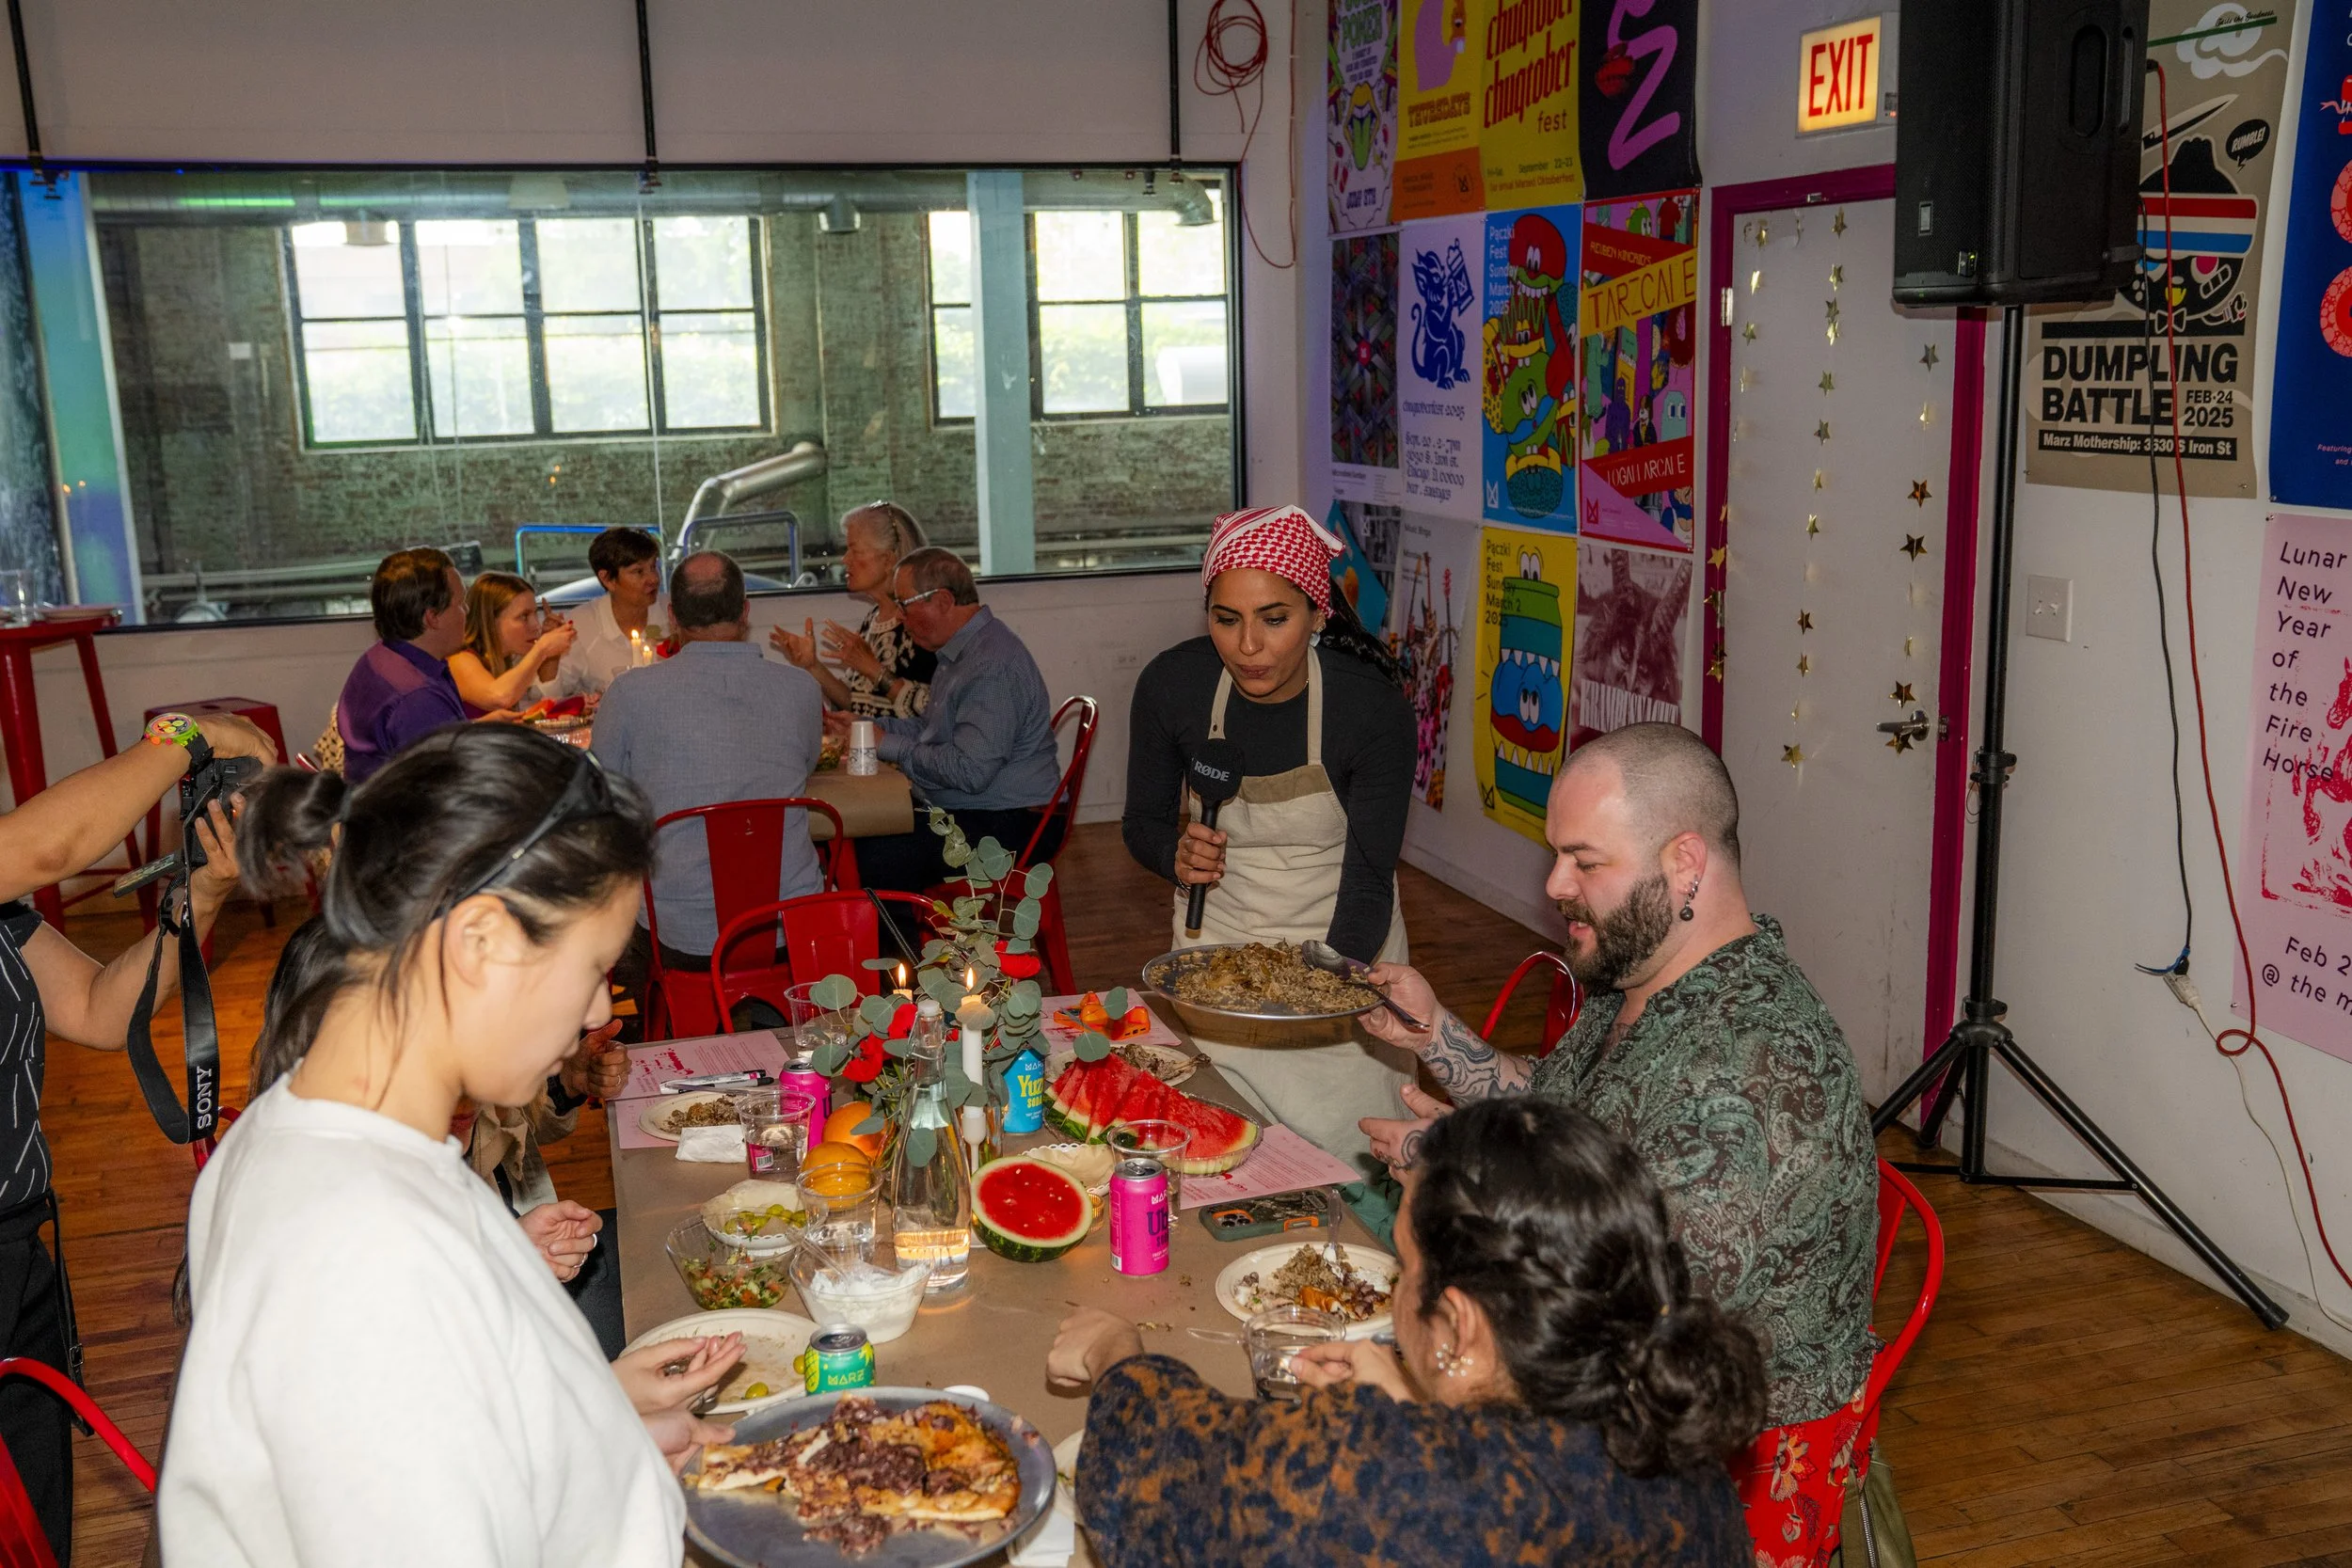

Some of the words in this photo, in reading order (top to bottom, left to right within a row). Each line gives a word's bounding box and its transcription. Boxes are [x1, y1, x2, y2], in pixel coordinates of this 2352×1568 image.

[1808, 33, 1873, 118] EXIT
[1537, 108, 1568, 135] fest
[2231, 126, 2267, 152] RUMBLE!
[1489, 245, 1508, 260] Fest
[1489, 262, 1519, 283] Sunday
[1488, 281, 1515, 297] March
[1488, 300, 1510, 316] 2025
[2042, 343, 2238, 383] DUMPLING
[2042, 388, 2174, 425] BATTLE
[2184, 406, 2234, 427] 2025
[2042, 434, 2071, 448] Marz
[2073, 436, 2141, 455] Mothership:
[2188, 443, 2215, 454] Iron
[2217, 445, 2233, 456] St
[2316, 444, 2352, 454] Featuring
[1486, 556, 1504, 573] Fest
[2280, 541, 2348, 569] Lunar
[1486, 575, 1517, 596] Sunday
[2277, 575, 2333, 605] New
[1486, 592, 1514, 611] March
[1516, 597, 1522, 613] 2
[2278, 610, 2332, 639] Year
[2272, 649, 2300, 669] of
[2269, 681, 2309, 707] the
[2265, 714, 2313, 743] Fire
[2262, 747, 2334, 783] Horse
[2284, 935, 2328, 968] Feb
[2262, 963, 2280, 988] @
[2290, 974, 2327, 1004] the
[196, 1065, 213, 1131] SONY
[827, 1368, 865, 1386] MARZ
